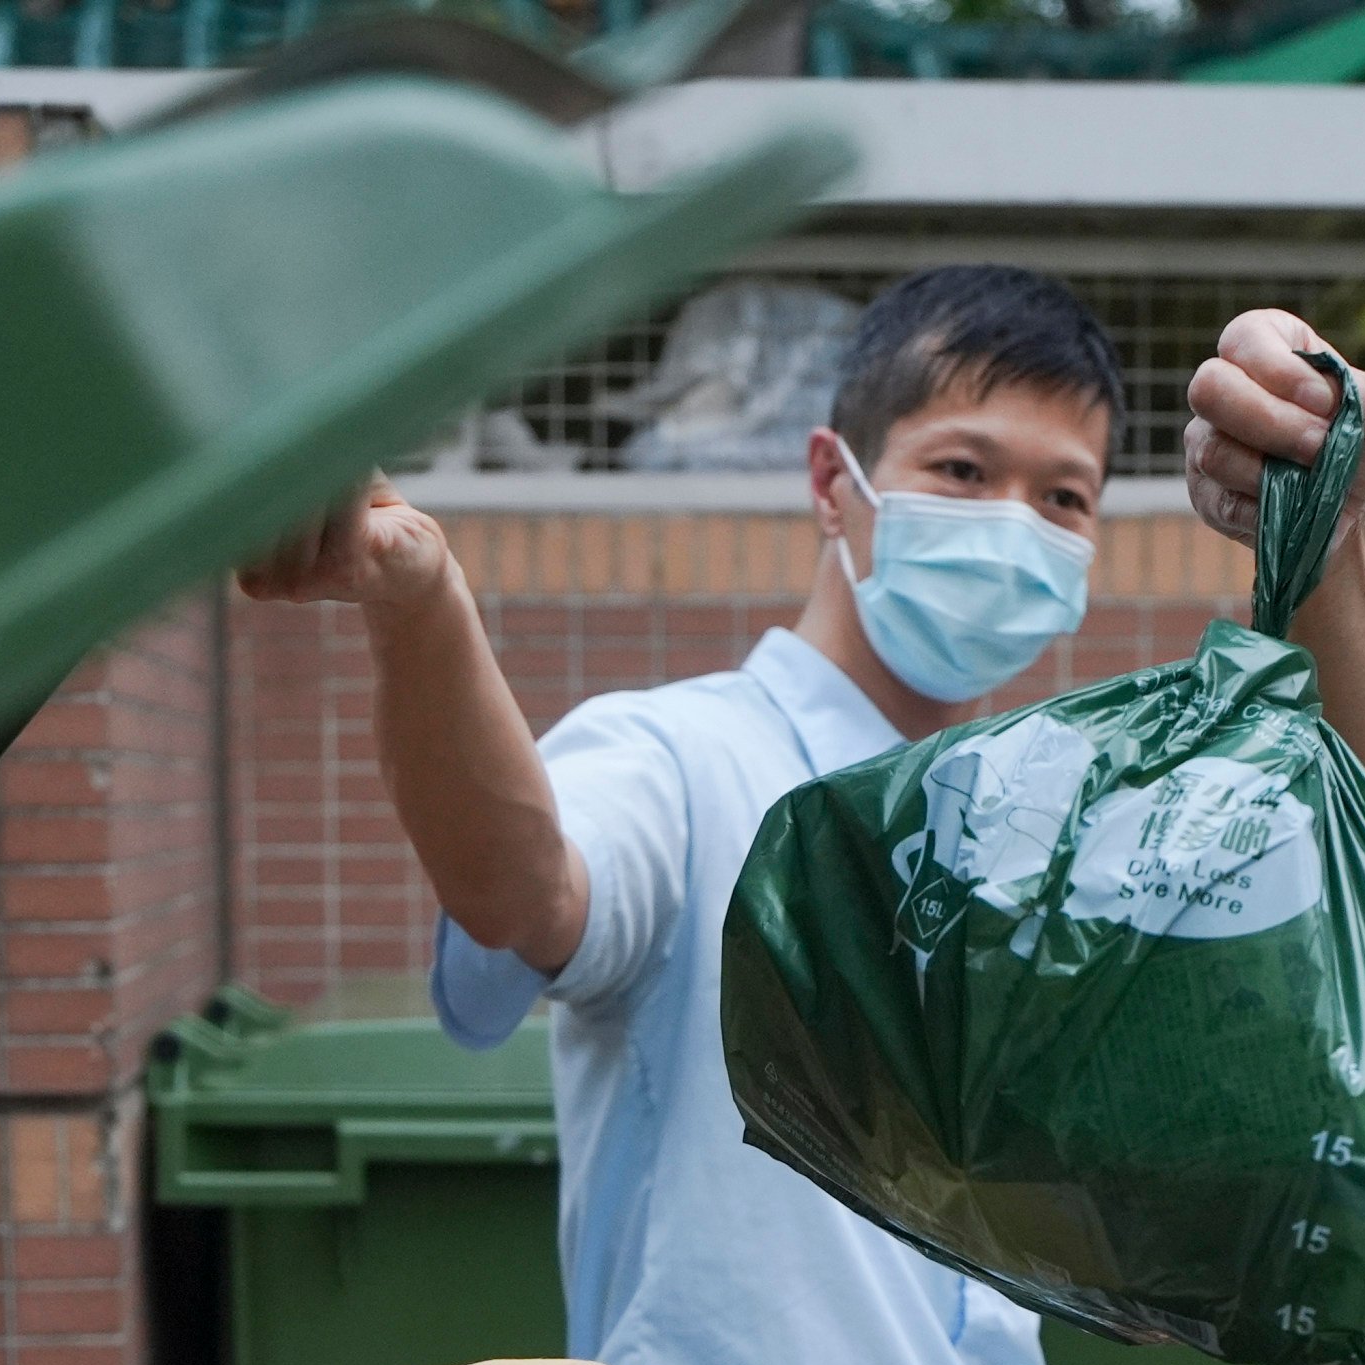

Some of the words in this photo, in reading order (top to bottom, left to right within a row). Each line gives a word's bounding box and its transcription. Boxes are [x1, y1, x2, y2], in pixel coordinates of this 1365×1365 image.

[919, 898, 943, 919] 15L
[1311, 1130, 1355, 1166] 15
[1291, 1219, 1332, 1254] 15
[1275, 1304, 1317, 1335] 15
